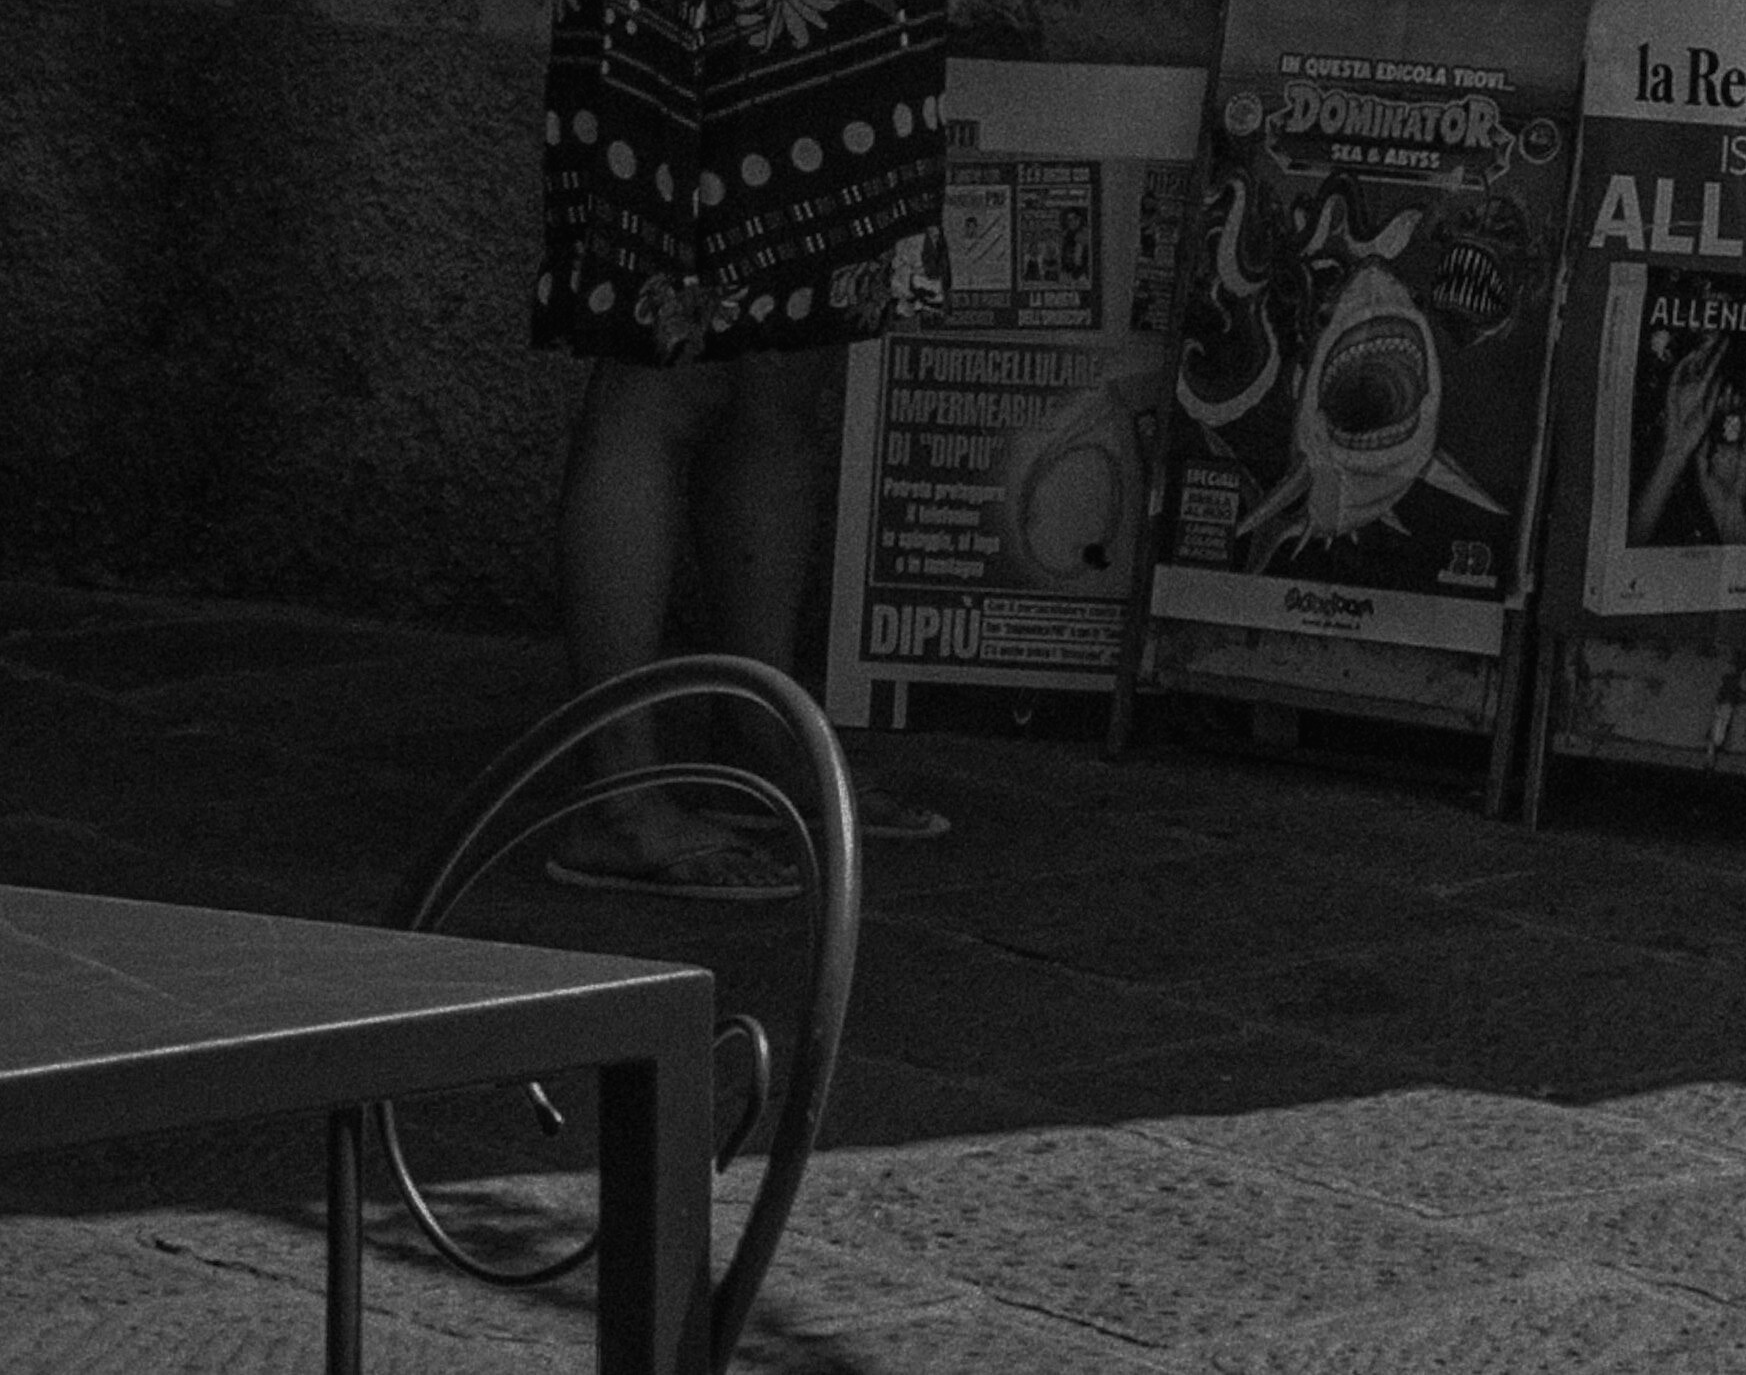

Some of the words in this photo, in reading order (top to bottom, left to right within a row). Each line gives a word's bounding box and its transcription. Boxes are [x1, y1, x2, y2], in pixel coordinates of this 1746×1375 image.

[1304, 56, 1372, 80] QUESTA
[1374, 62, 1447, 86] EDICOLA
[1634, 44, 1674, 105] la
[1284, 84, 1495, 148] DOMINATOR
[1330, 143, 1363, 162] SEA
[1383, 147, 1441, 169] ABYSS
[892, 344, 914, 380] IL
[918, 346, 1099, 388] PORTACELLULARE
[889, 388, 1058, 430] IMPERMEABILE
[886, 431, 911, 467] DI
[870, 594, 982, 660] DIPIÙ
